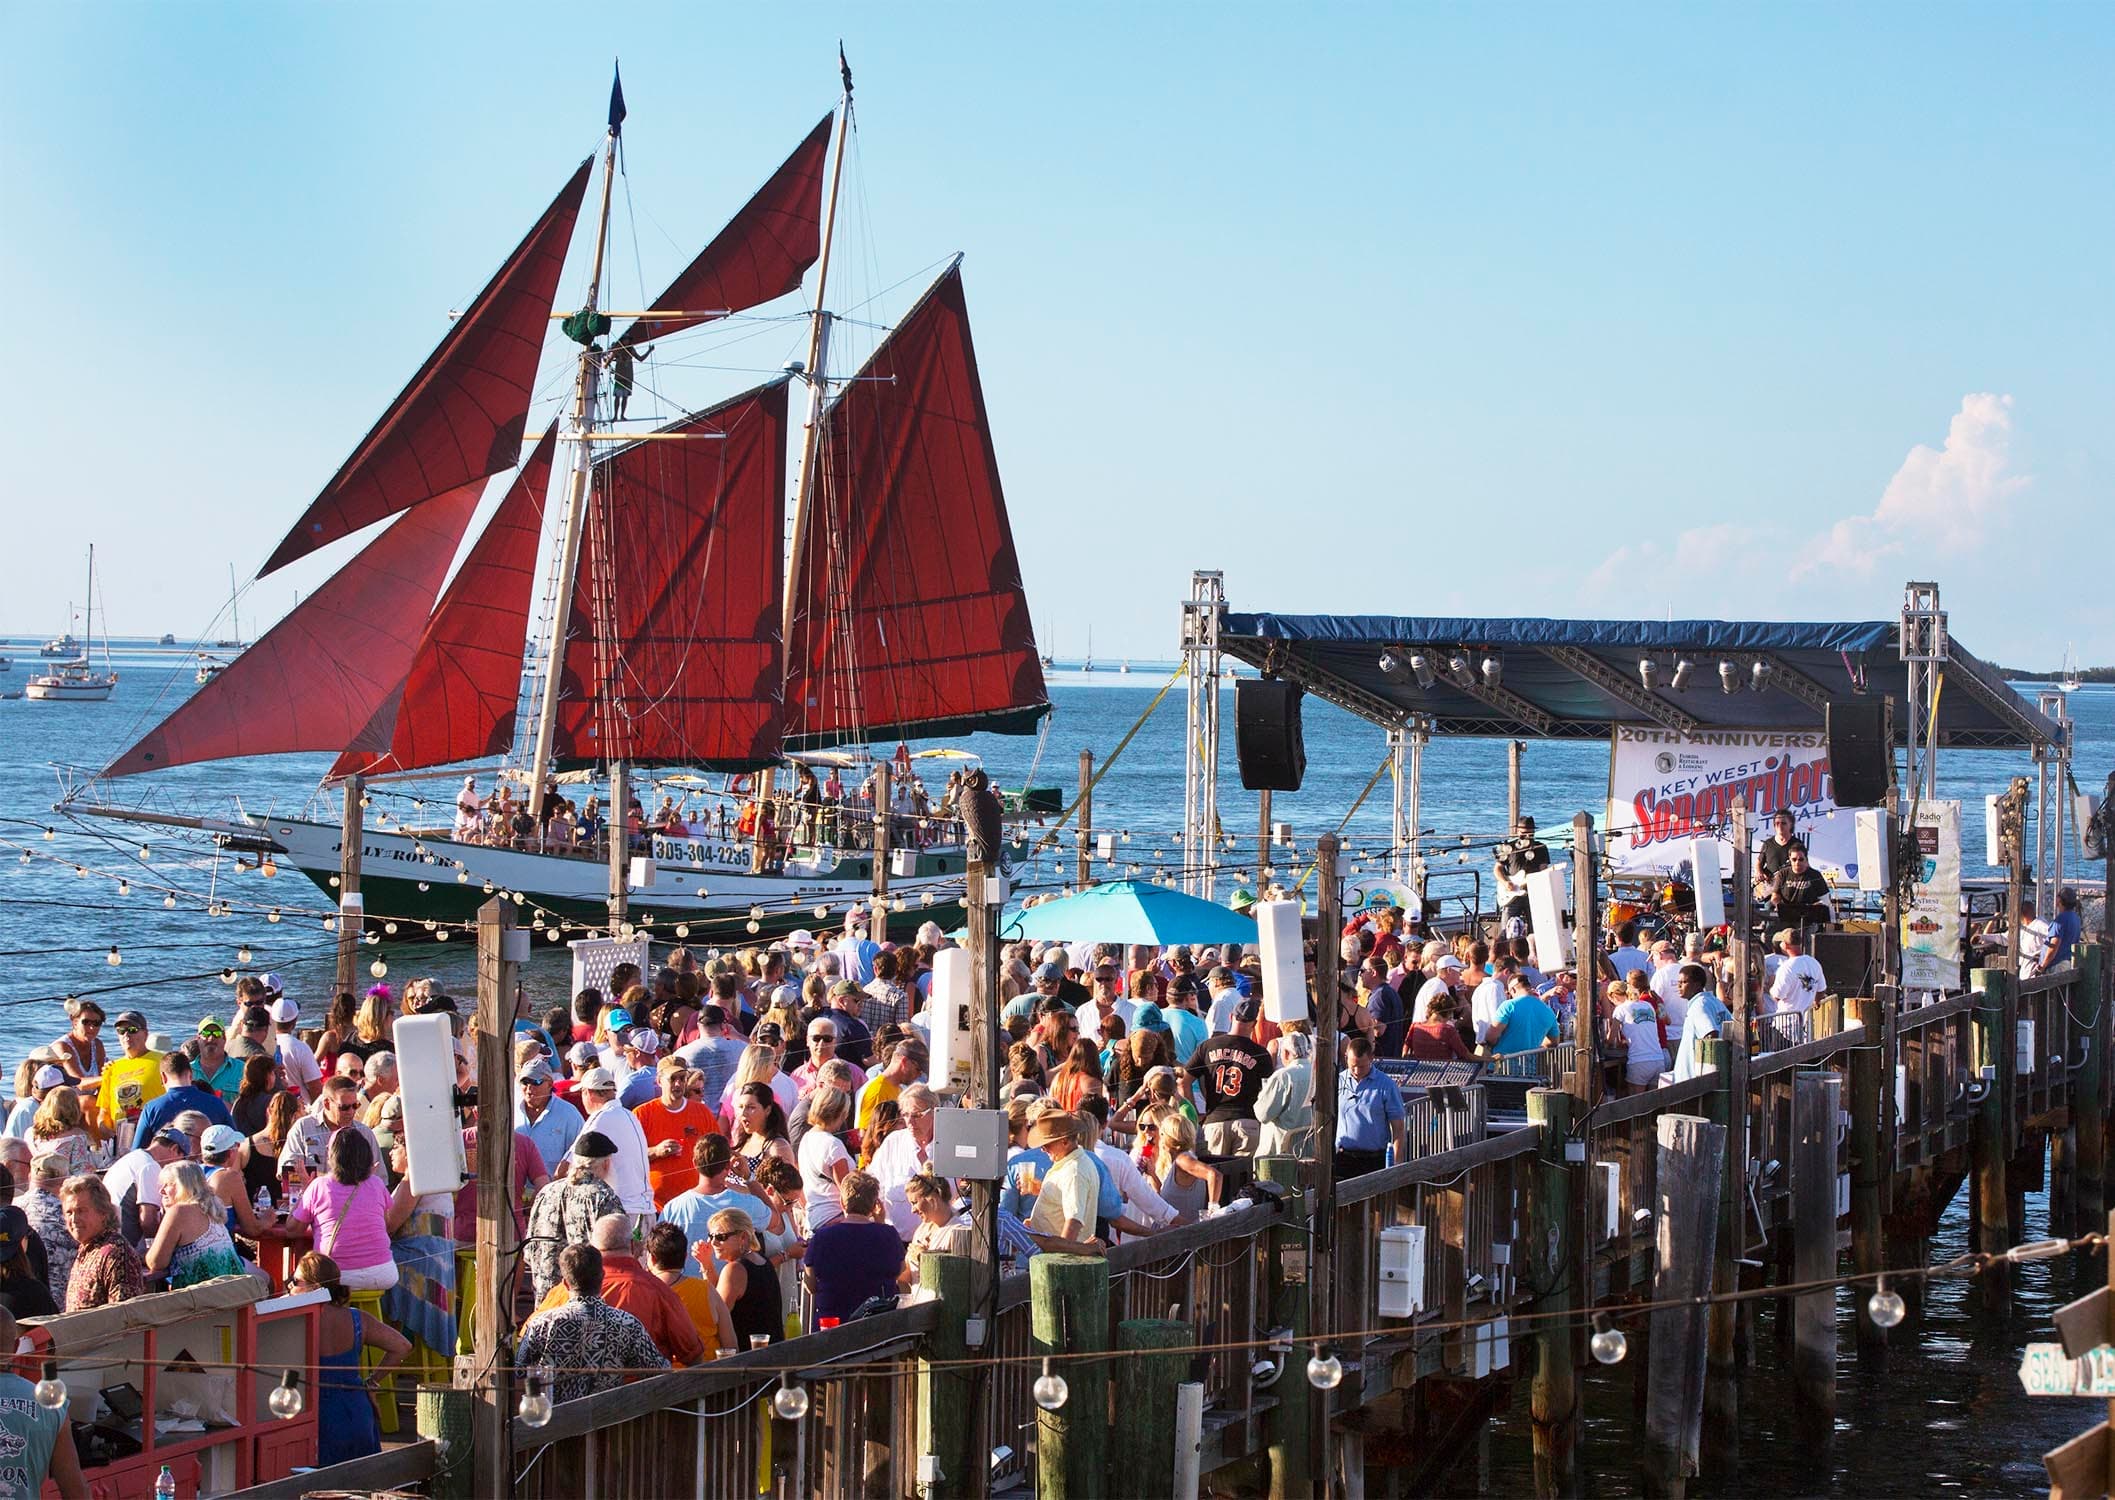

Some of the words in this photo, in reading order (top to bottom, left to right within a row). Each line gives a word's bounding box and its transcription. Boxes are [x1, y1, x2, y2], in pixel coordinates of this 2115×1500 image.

[1620, 728, 1681, 745] 20TH
[1661, 776, 1698, 797] KEY
[1705, 760, 1761, 785] WEST
[1919, 811, 1942, 822] Radio
[655, 841, 751, 867] 305-304-2235
[1208, 1048, 1257, 1070] MACHADO
[1216, 1065, 1243, 1096] 13
